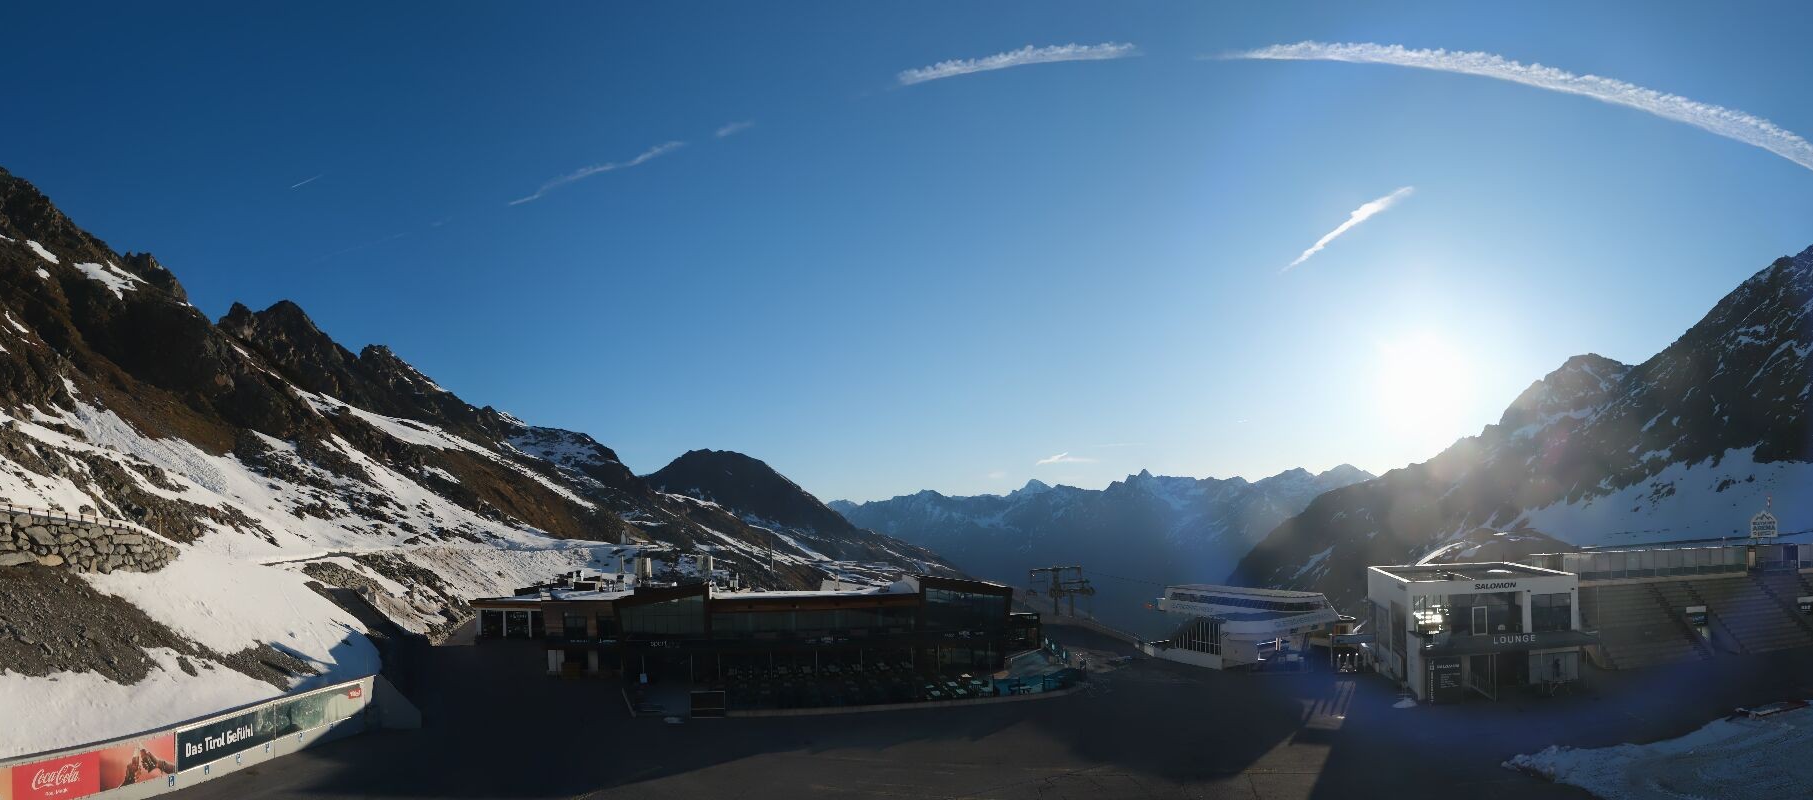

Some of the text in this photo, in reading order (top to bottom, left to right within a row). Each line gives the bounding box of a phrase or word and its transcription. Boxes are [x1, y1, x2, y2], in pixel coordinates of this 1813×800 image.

[1474, 582, 1517, 590] SALOMON
[1493, 634, 1536, 645] LOUNGE
[185, 723, 254, 758] Das Tirol Gefühl
